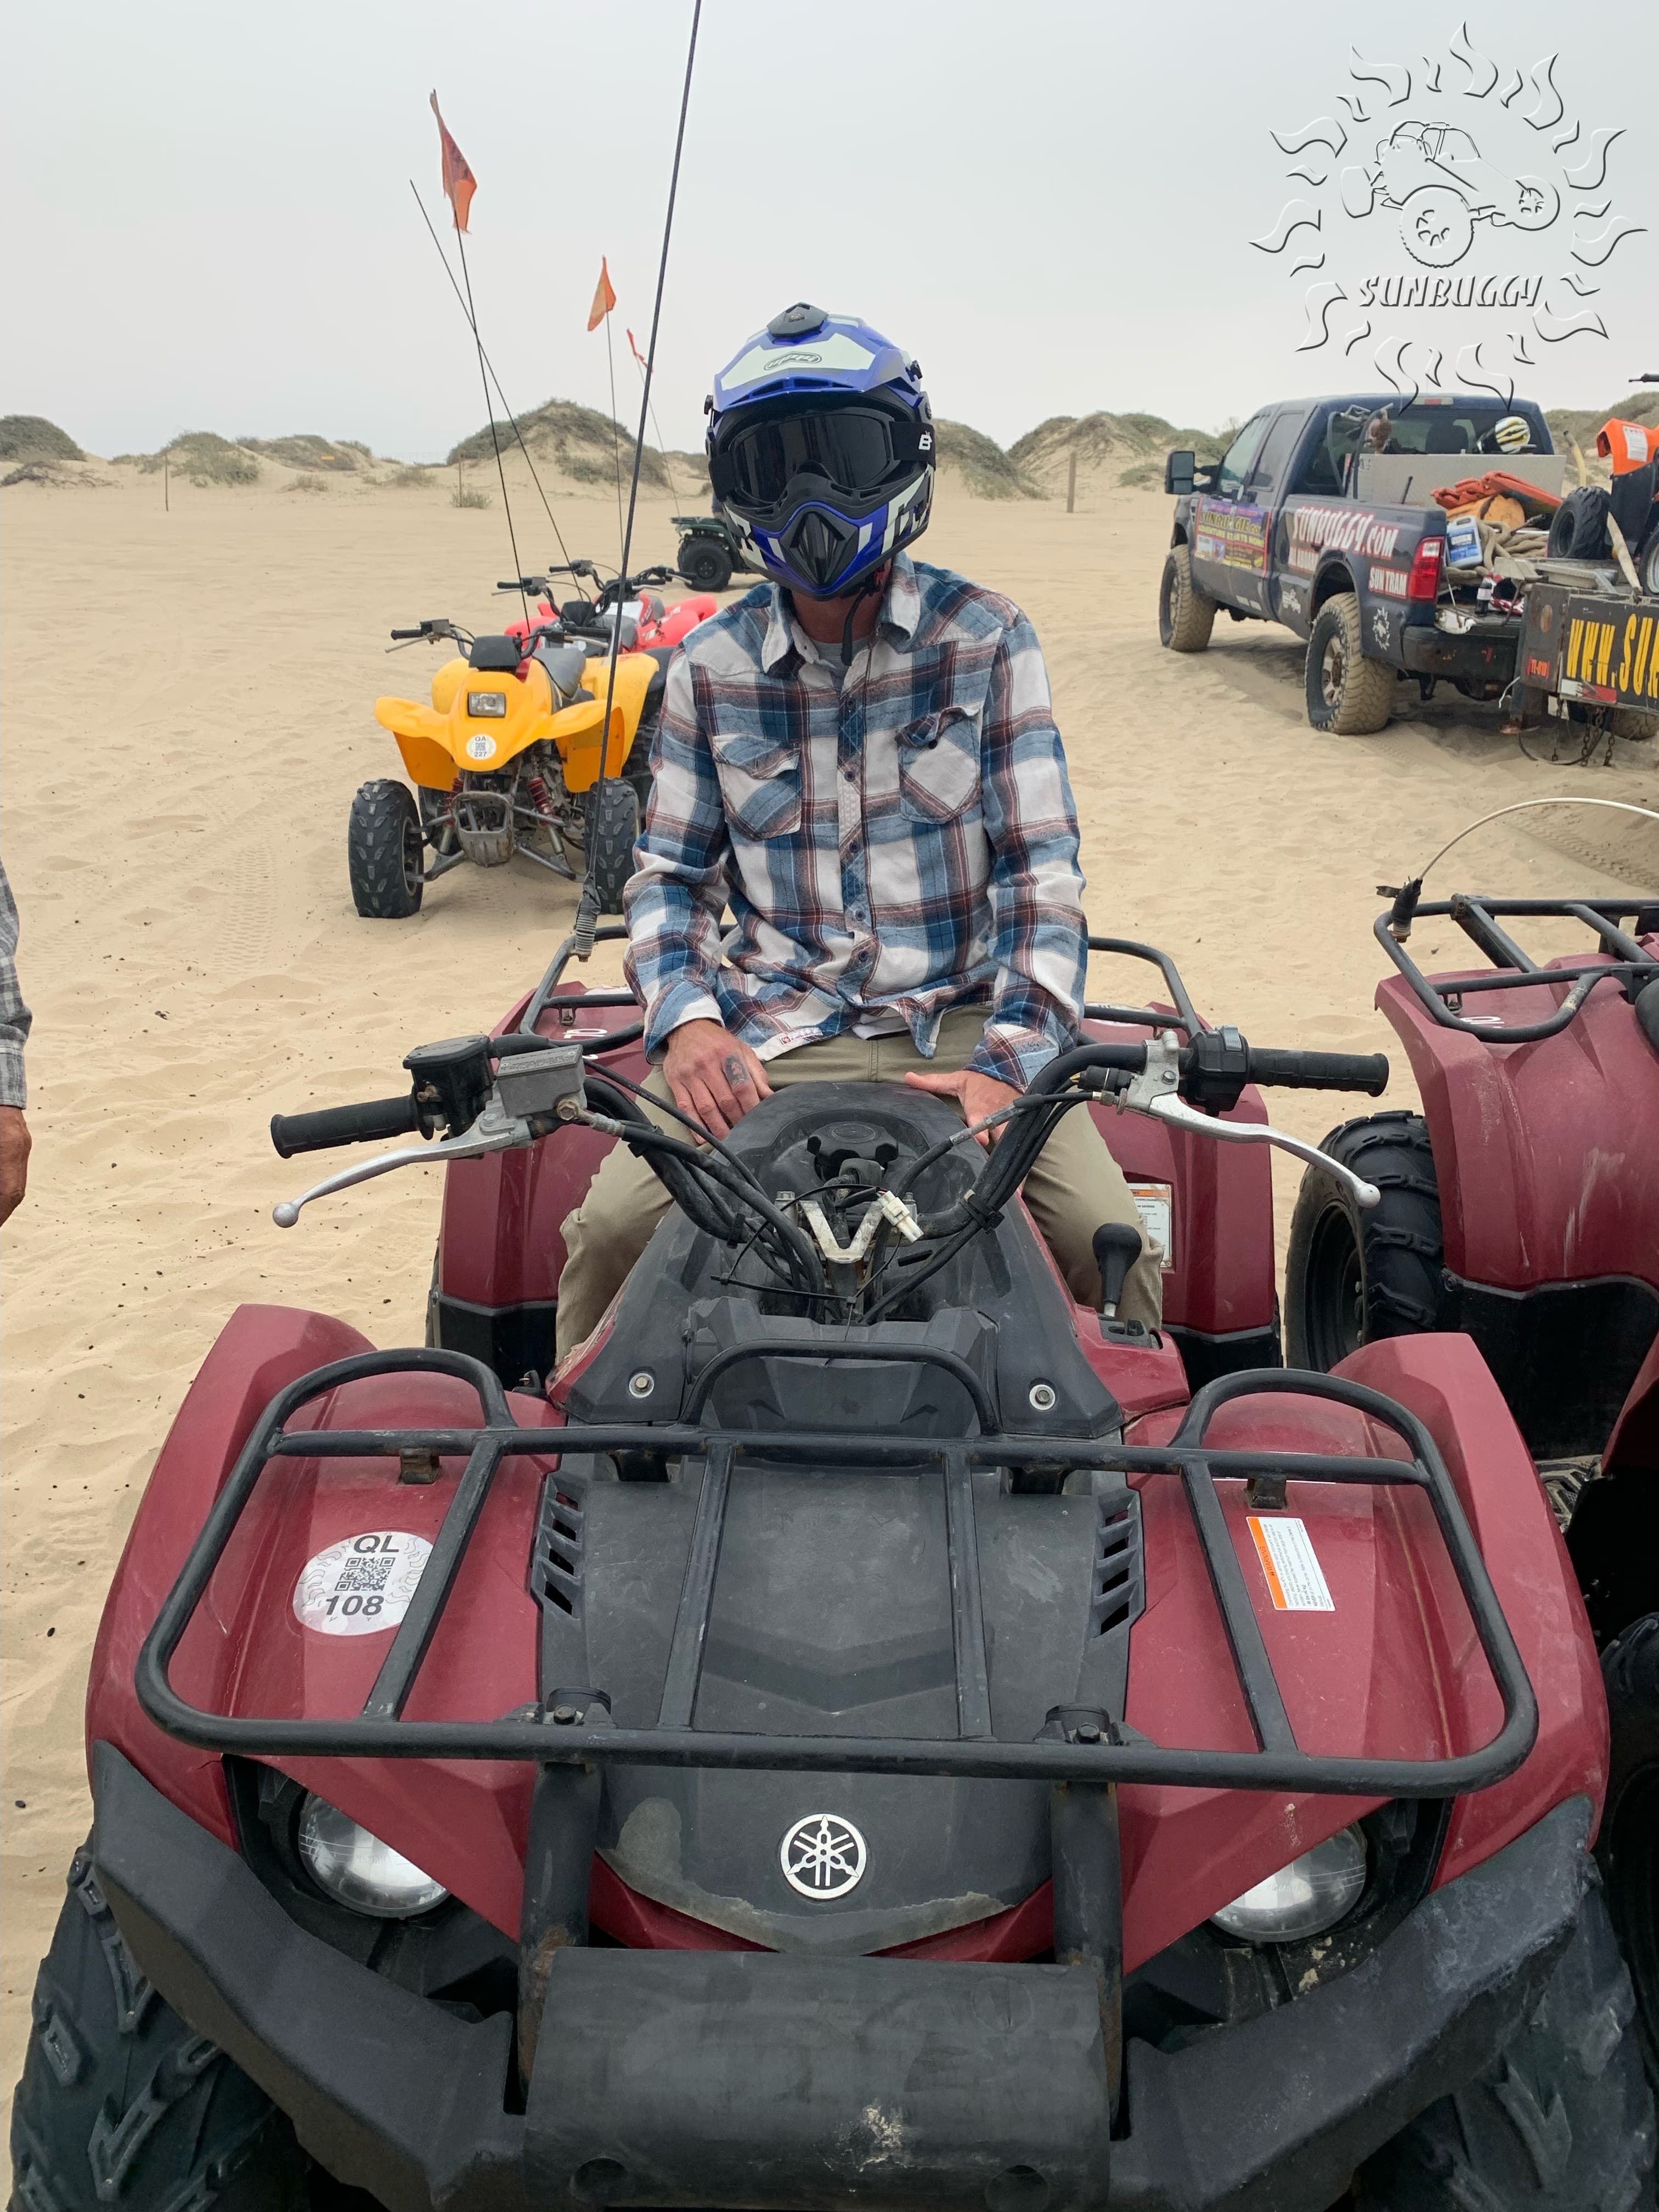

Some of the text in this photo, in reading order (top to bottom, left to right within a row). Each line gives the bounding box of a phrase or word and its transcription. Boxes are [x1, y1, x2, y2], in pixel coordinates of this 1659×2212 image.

[1369, 566, 1408, 598] SUN TRAM
[353, 1535, 400, 1554] QL
[325, 1595, 385, 1616] 108
